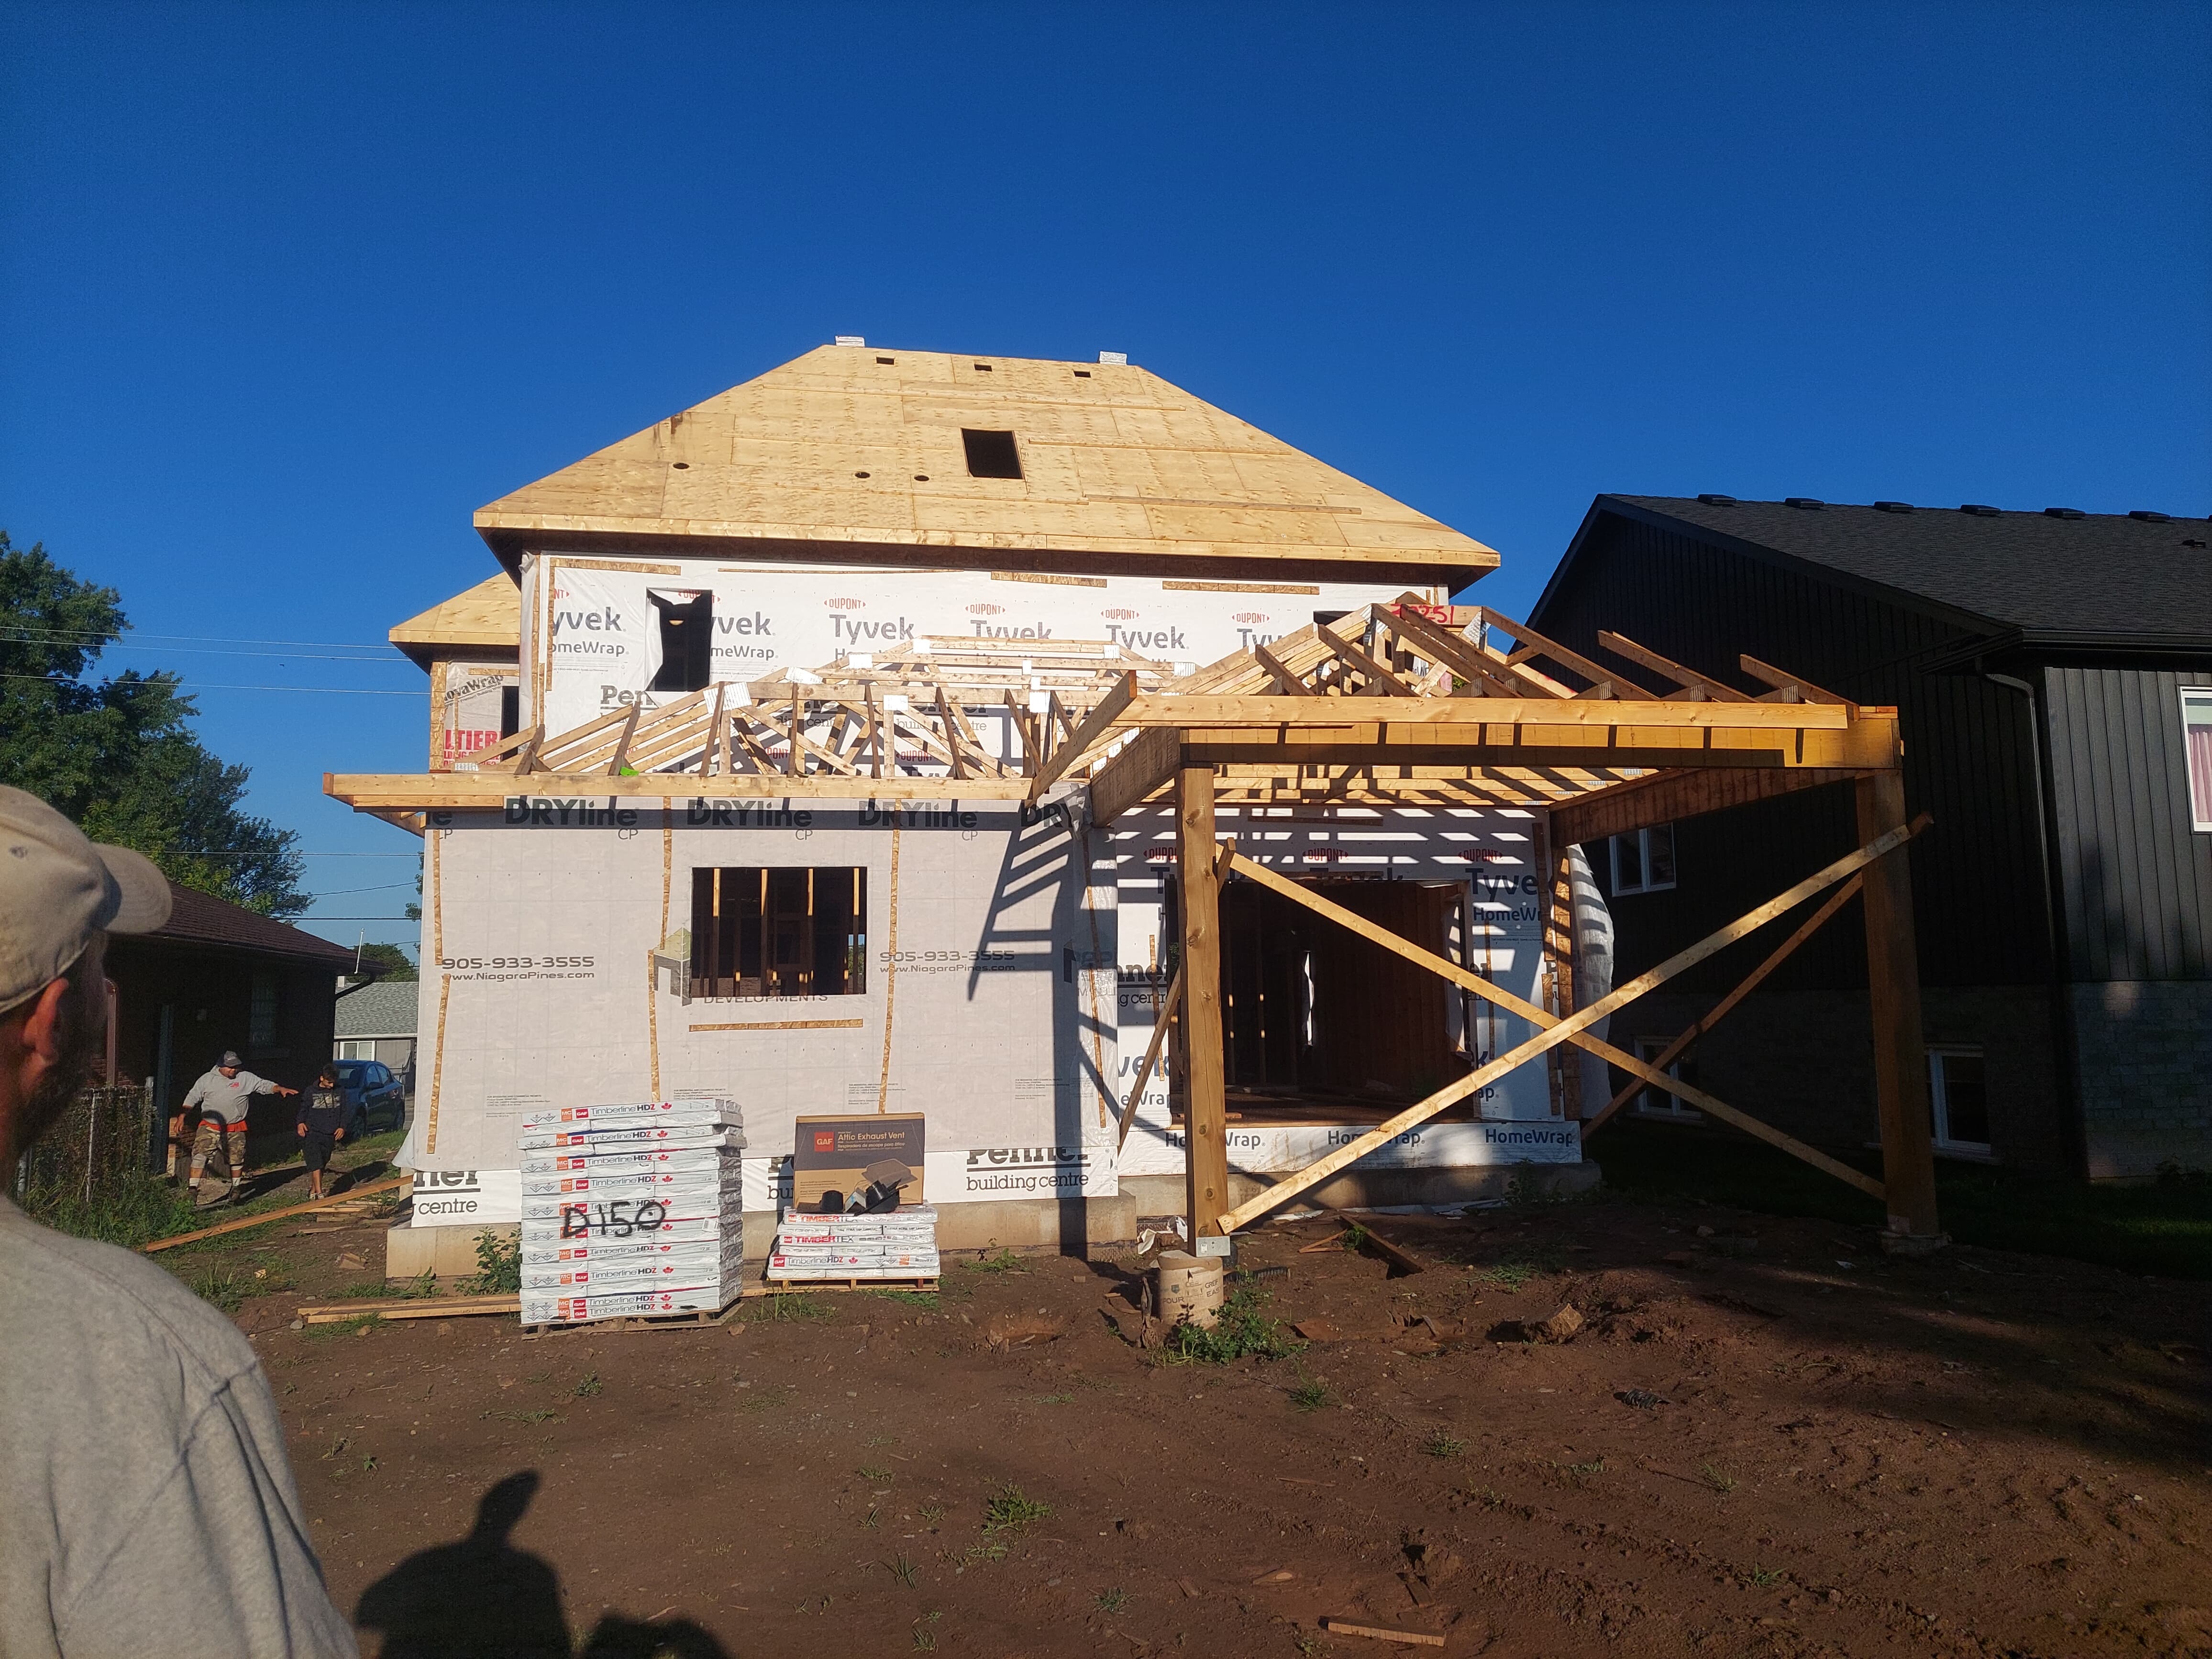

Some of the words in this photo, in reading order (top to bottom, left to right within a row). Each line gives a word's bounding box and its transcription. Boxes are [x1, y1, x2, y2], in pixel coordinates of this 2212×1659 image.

[829, 598, 861, 609] DUPONT
[970, 604, 1001, 615] DUPONT
[1105, 608, 1135, 619] DUPONT
[1236, 613, 1266, 624] DUPONT
[829, 614, 914, 645] Tyvek
[1106, 625, 1184, 650] Tyvek
[505, 798, 638, 826] DRYline
[687, 799, 812, 827] DRYline
[858, 801, 978, 828] DRYline
[618, 828, 639, 841] CP
[795, 829, 813, 841] CP
[962, 830, 978, 841] CP
[1308, 848, 1344, 861] DUPONT
[1463, 848, 1498, 862] DUPONT
[442, 956, 595, 970] 905-933-3555
[879, 951, 1015, 962] 905-933-3555
[590, 1106, 636, 1116] Timberline
[586, 1133, 632, 1143] Timberline
[632, 1130, 652, 1139] HDZ
[1486, 1129, 1572, 1147] HomeWrap
[587, 1156, 633, 1166] Timberline
[591, 1178, 637, 1187] Timberline
[966, 1174, 1037, 1192] building
[1039, 1172, 1089, 1187] centre
[419, 1198, 478, 1215] centre
[590, 1247, 635, 1256] Timberline
[591, 1270, 637, 1280] Timberline
[637, 1267, 657, 1275] HDZ
[588, 1296, 635, 1306] Timberline
[589, 1306, 635, 1316] Timberline
